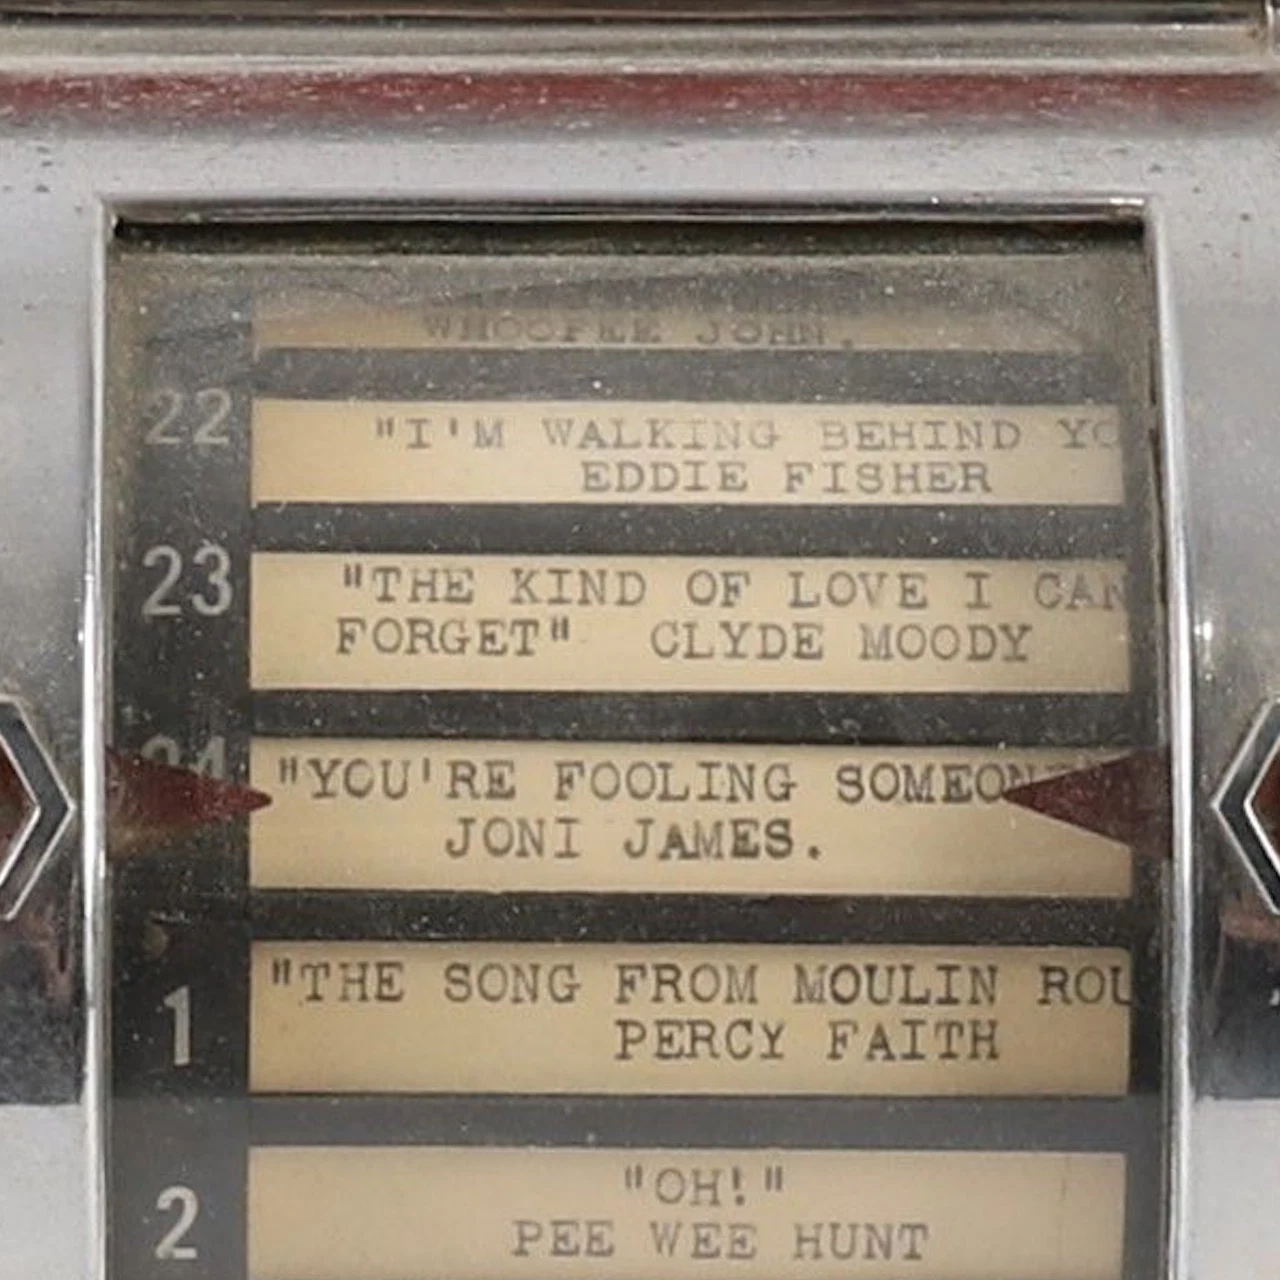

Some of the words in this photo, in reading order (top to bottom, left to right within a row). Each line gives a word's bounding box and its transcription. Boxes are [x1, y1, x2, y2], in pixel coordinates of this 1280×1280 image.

[145, 389, 231, 446] 22
[544, 419, 780, 451] WALKING
[822, 421, 1022, 451] BEHIND
[581, 461, 749, 494] EDDIE
[785, 461, 992, 494] FISHER
[141, 545, 233, 616] 23
[343, 564, 474, 604] "THE
[510, 568, 646, 606] KIND
[686, 569, 751, 608] OF
[789, 570, 929, 609] LOVE
[966, 572, 993, 610] I
[336, 618, 570, 656] FORGET"
[651, 622, 824, 660] CLYDE
[859, 624, 1032, 663] MOODY
[554, 761, 798, 803] FOOLING
[445, 818, 583, 859] JONI
[624, 818, 822, 861] JAMES.
[272, 958, 406, 1004] "THE
[444, 963, 582, 1004] SONG
[614, 963, 759, 1005] FROM
[792, 963, 1000, 1006] MOULIN
[163, 985, 192, 1067] 1
[614, 1019, 786, 1061] PERCY
[826, 1019, 1000, 1061] FAITH
[154, 1185, 200, 1260] 2
[511, 1221, 616, 1258] PEE
[650, 1222, 758, 1260] WEE
[793, 1224, 930, 1261] HUNT
